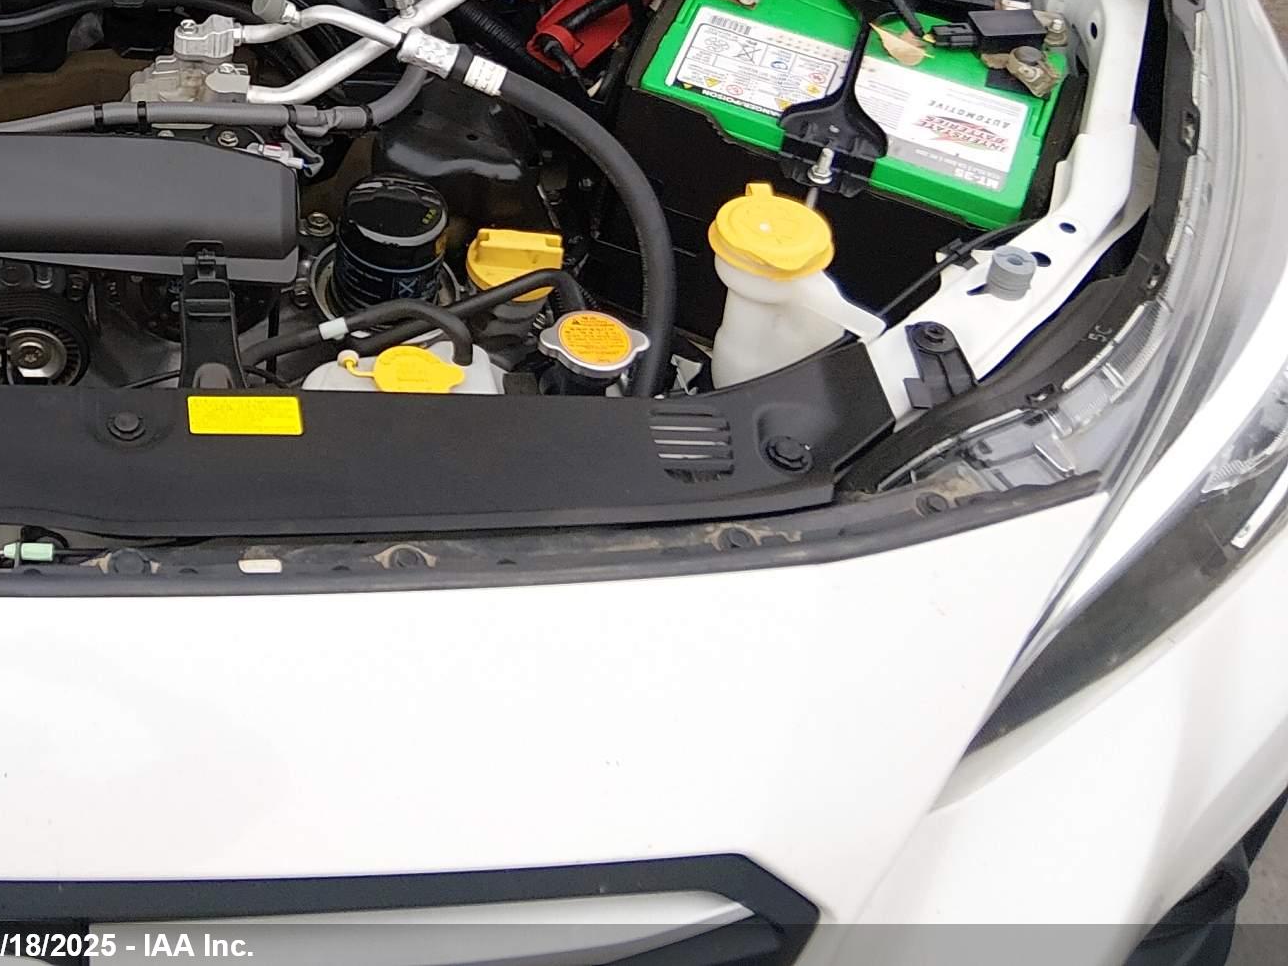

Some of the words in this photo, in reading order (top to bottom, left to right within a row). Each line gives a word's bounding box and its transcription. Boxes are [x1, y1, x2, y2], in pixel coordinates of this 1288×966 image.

[927, 99, 1011, 129] AUTOMOTIVE
[915, 120, 1008, 152] INTERSTATE
[923, 115, 1007, 144] BATTERIES
[953, 167, 1000, 189] MT-35
